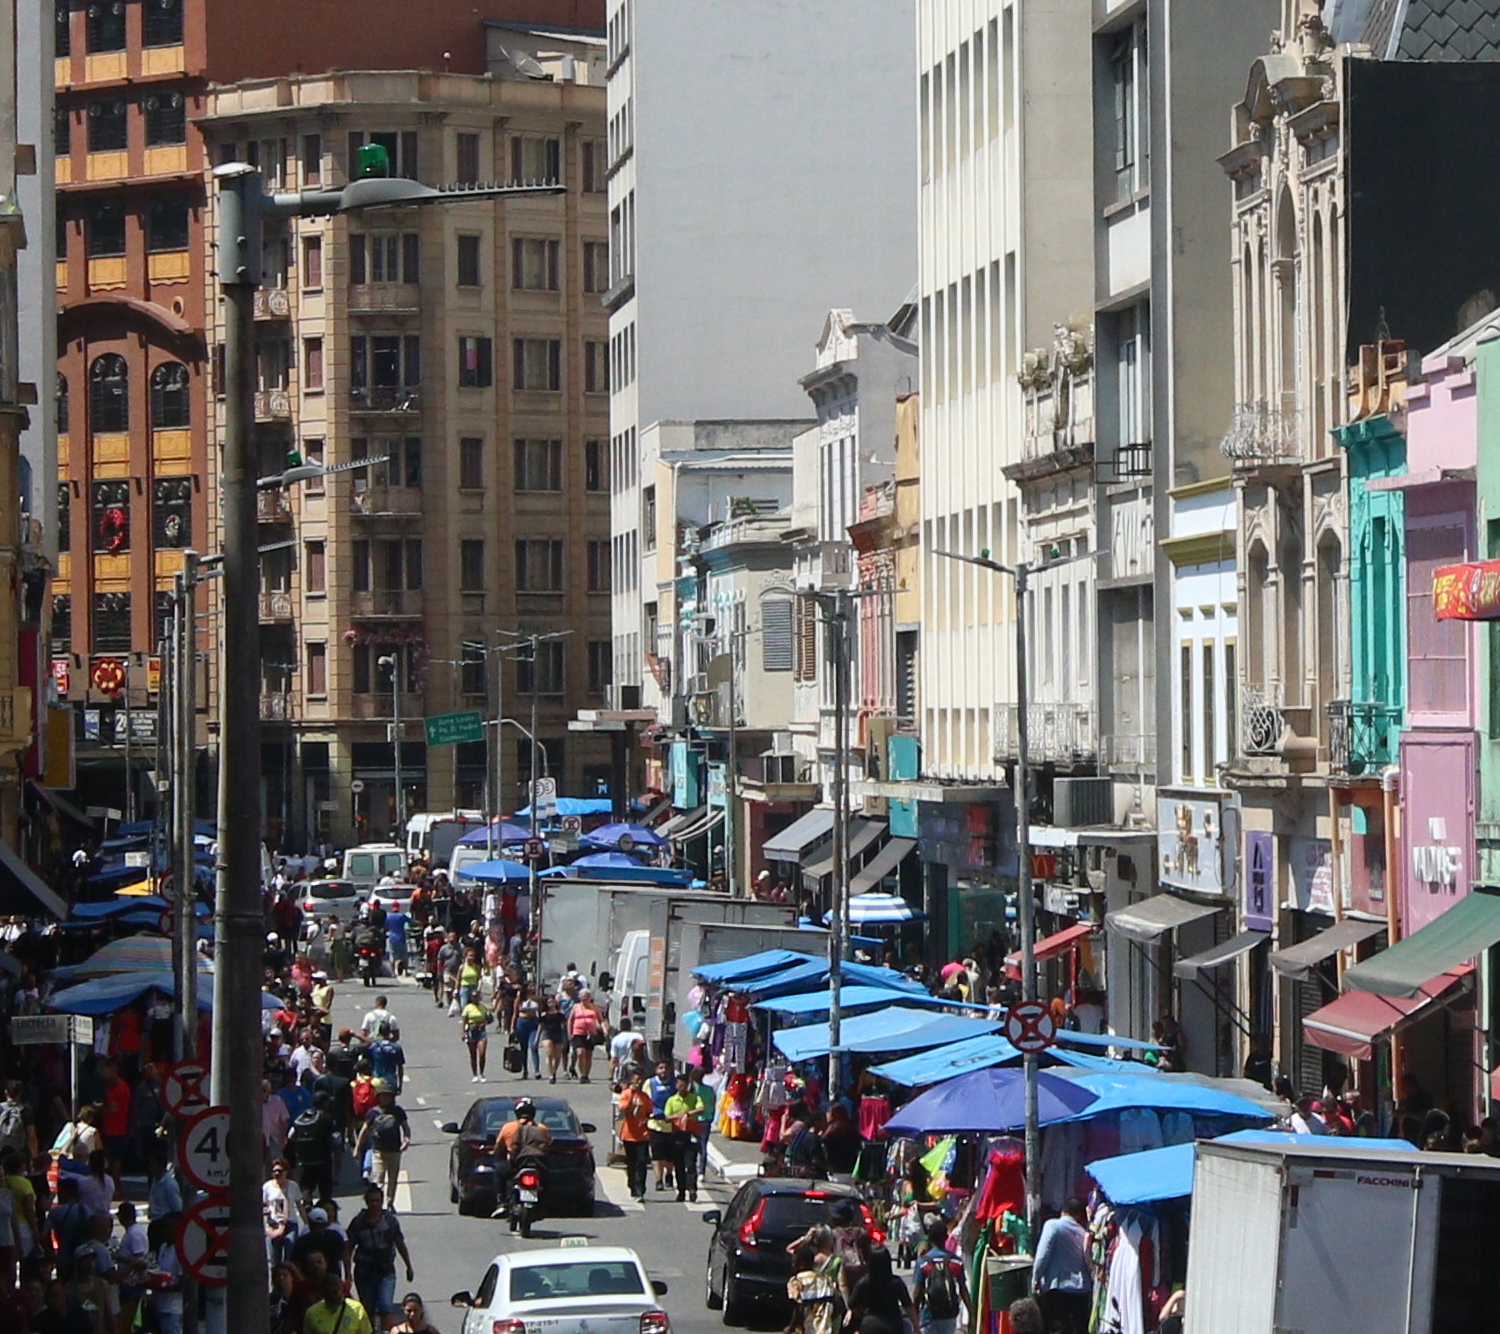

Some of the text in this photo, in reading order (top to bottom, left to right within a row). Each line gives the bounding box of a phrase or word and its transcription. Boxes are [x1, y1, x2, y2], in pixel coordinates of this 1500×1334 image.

[206, 1167, 230, 1179] km/
[1357, 1176, 1409, 1188] FACCHINI
[565, 1238, 586, 1247] TAXI
